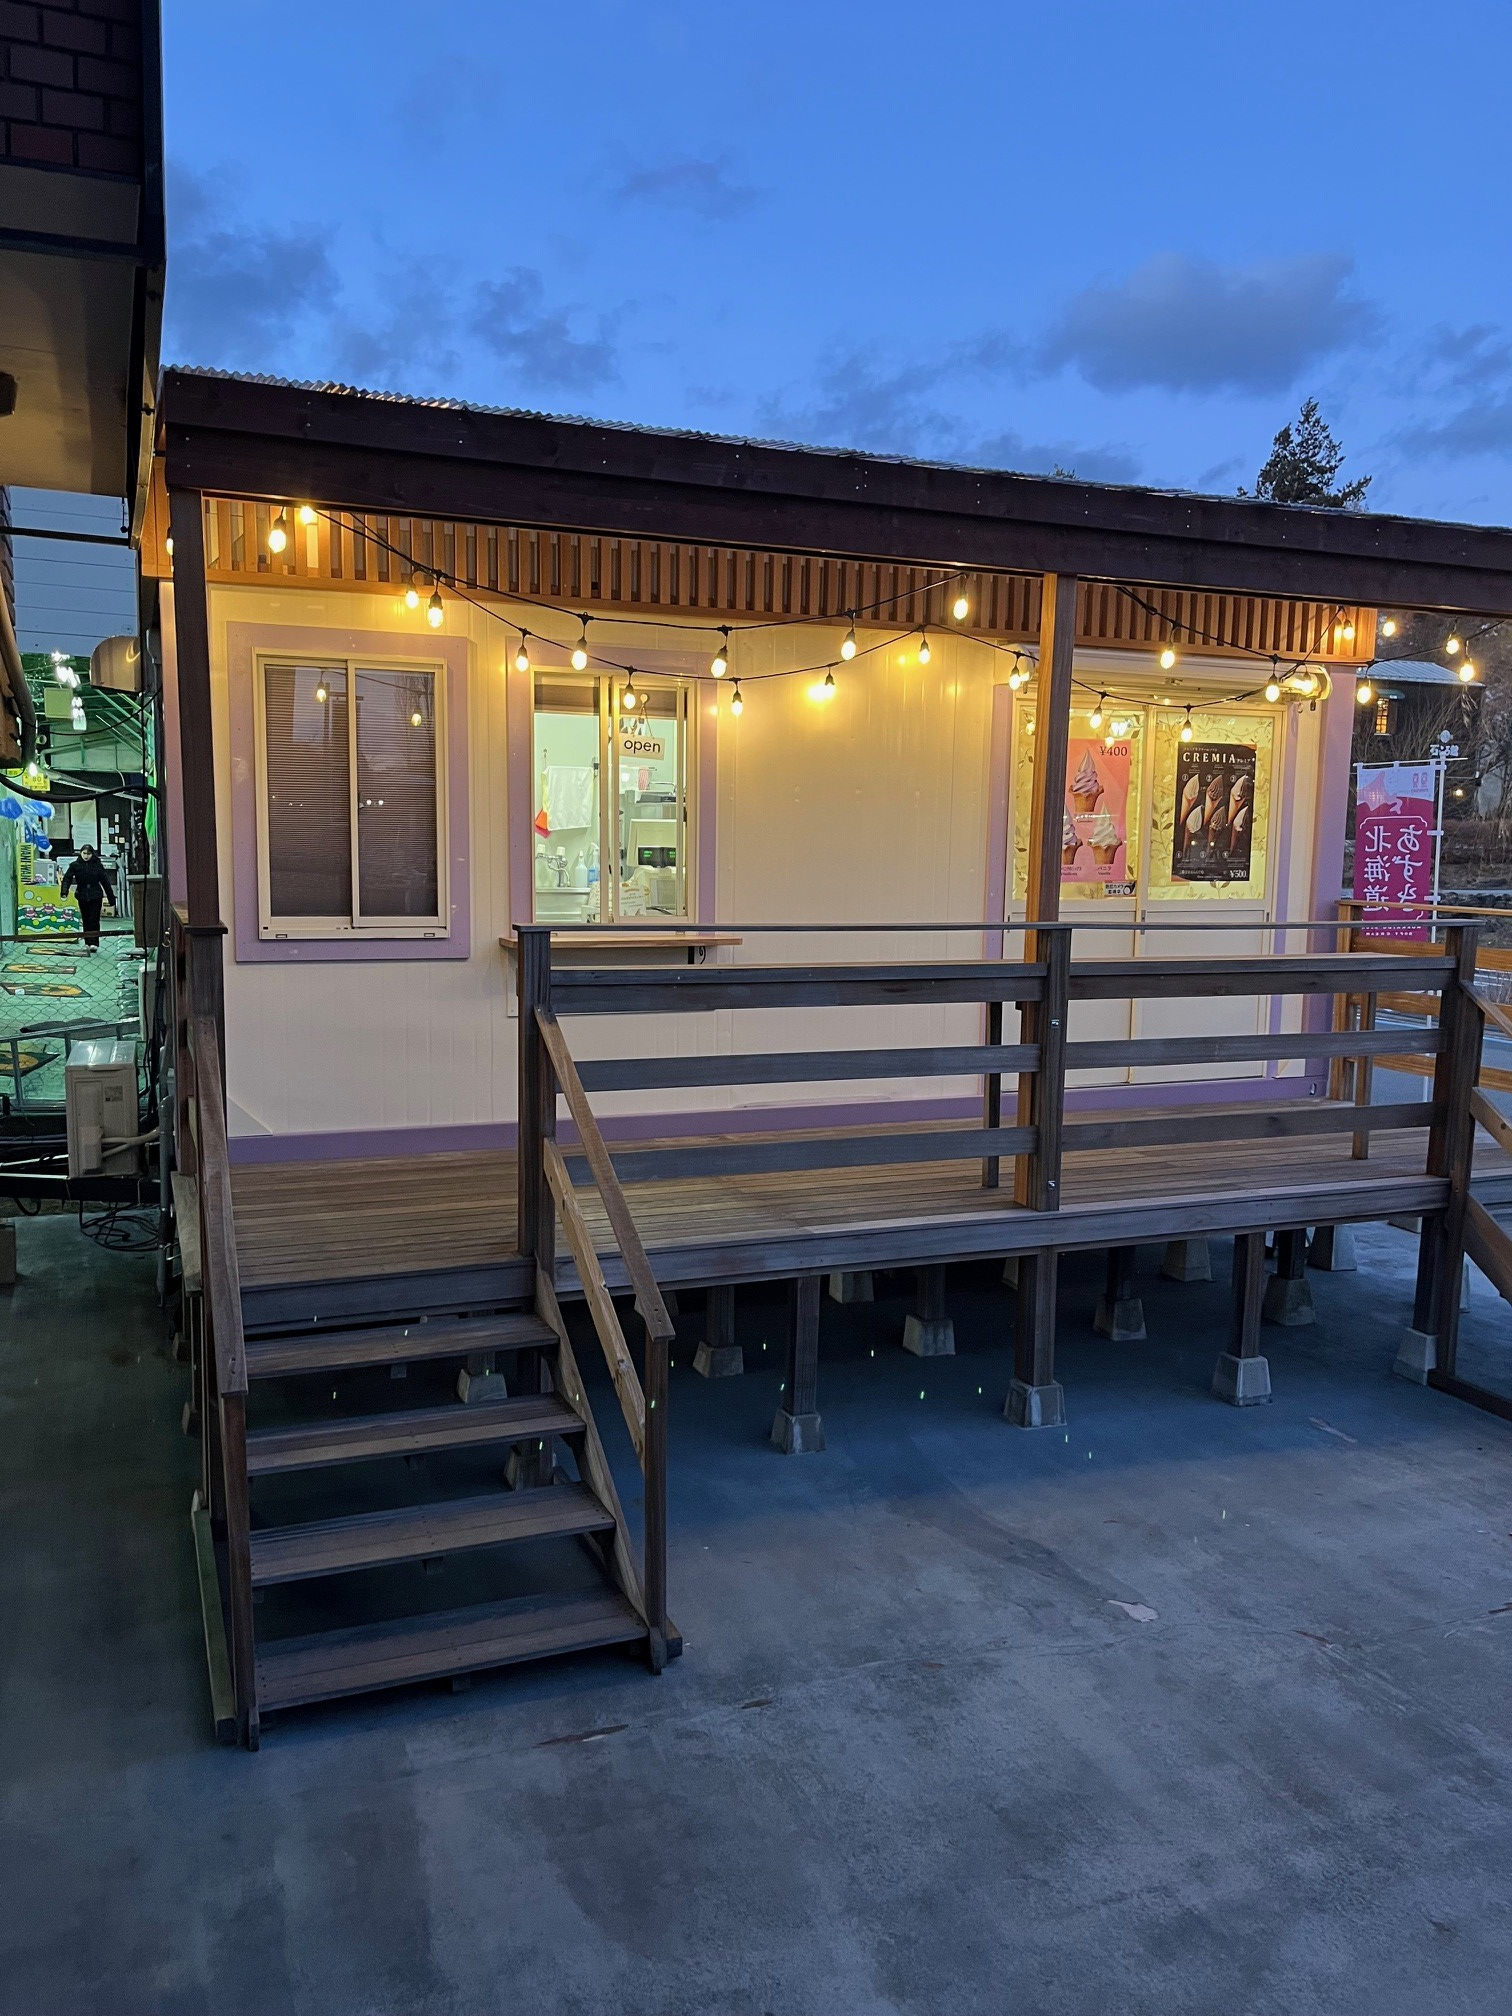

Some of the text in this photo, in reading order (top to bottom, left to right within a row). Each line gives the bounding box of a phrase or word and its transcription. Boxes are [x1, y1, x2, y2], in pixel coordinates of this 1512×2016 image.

[623, 737, 661, 754] open
[1099, 745, 1128, 757] ¥400
[1182, 752, 1236, 764] CREMIA
[1229, 869, 1247, 879] ¥500
